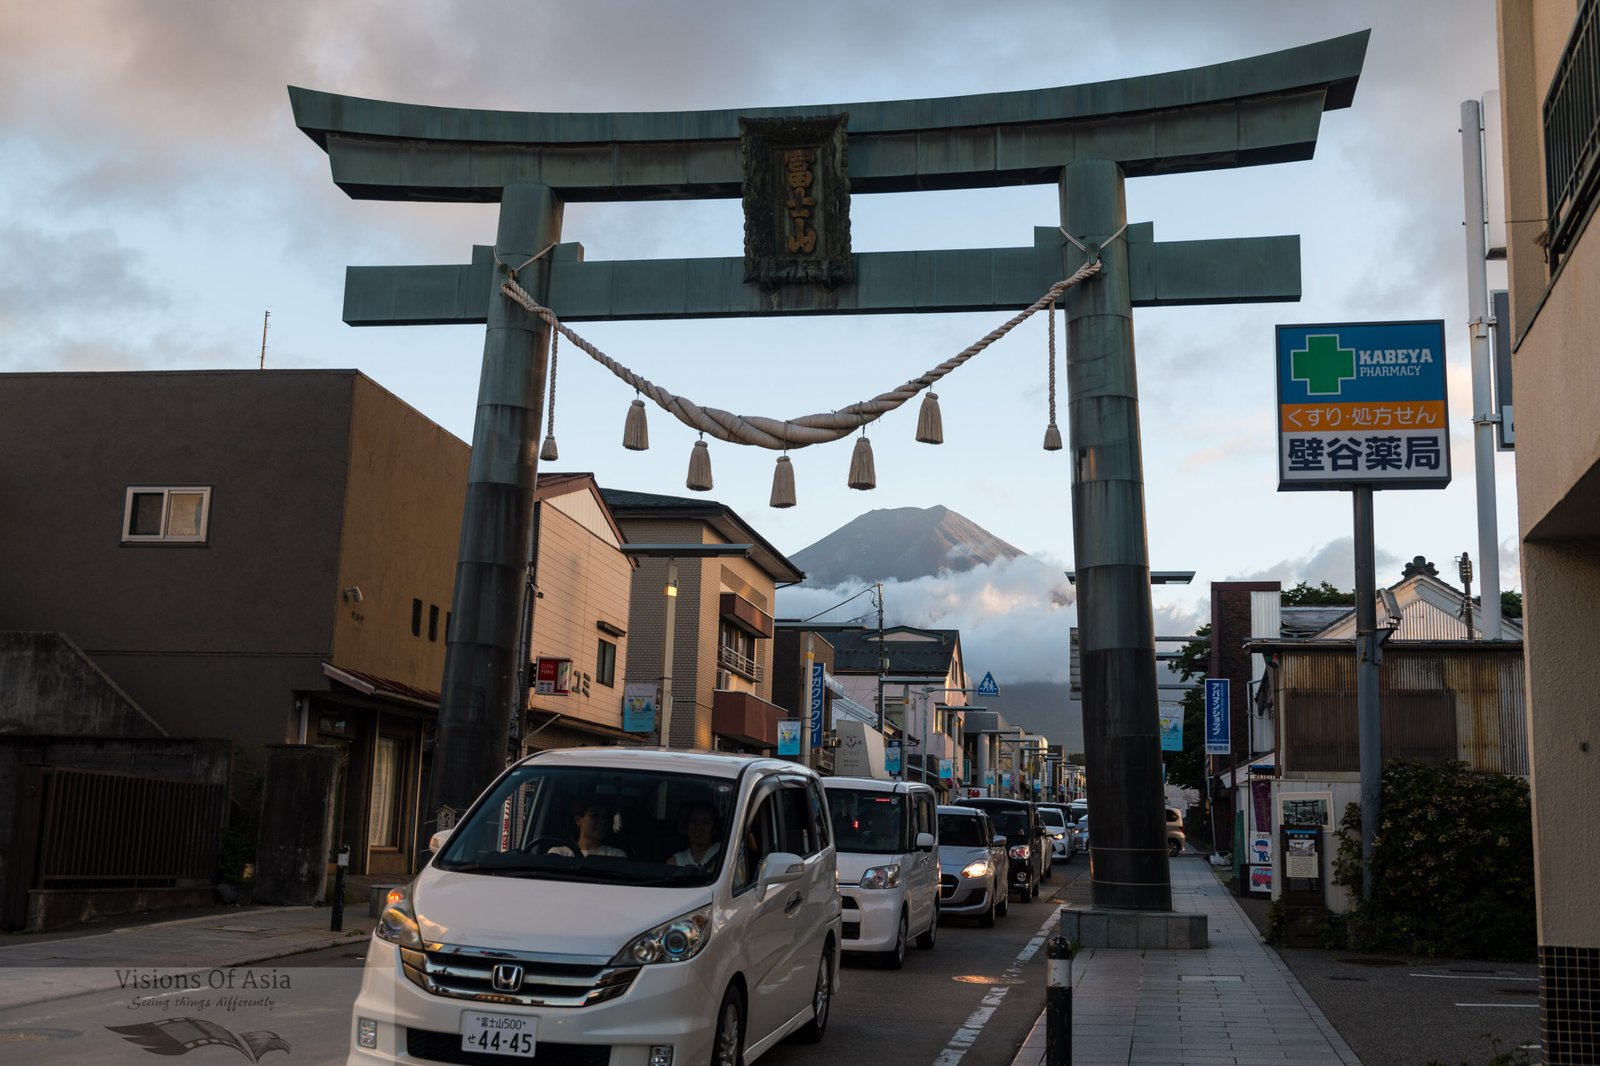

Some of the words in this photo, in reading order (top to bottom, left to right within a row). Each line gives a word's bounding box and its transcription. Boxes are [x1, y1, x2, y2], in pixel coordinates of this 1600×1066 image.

[1359, 348, 1433, 365] KABEYA
[1360, 365, 1422, 377] PHARMACY
[1288, 436, 1440, 472] 壁谷薬局
[478, 1030, 533, 1054] 44-45
